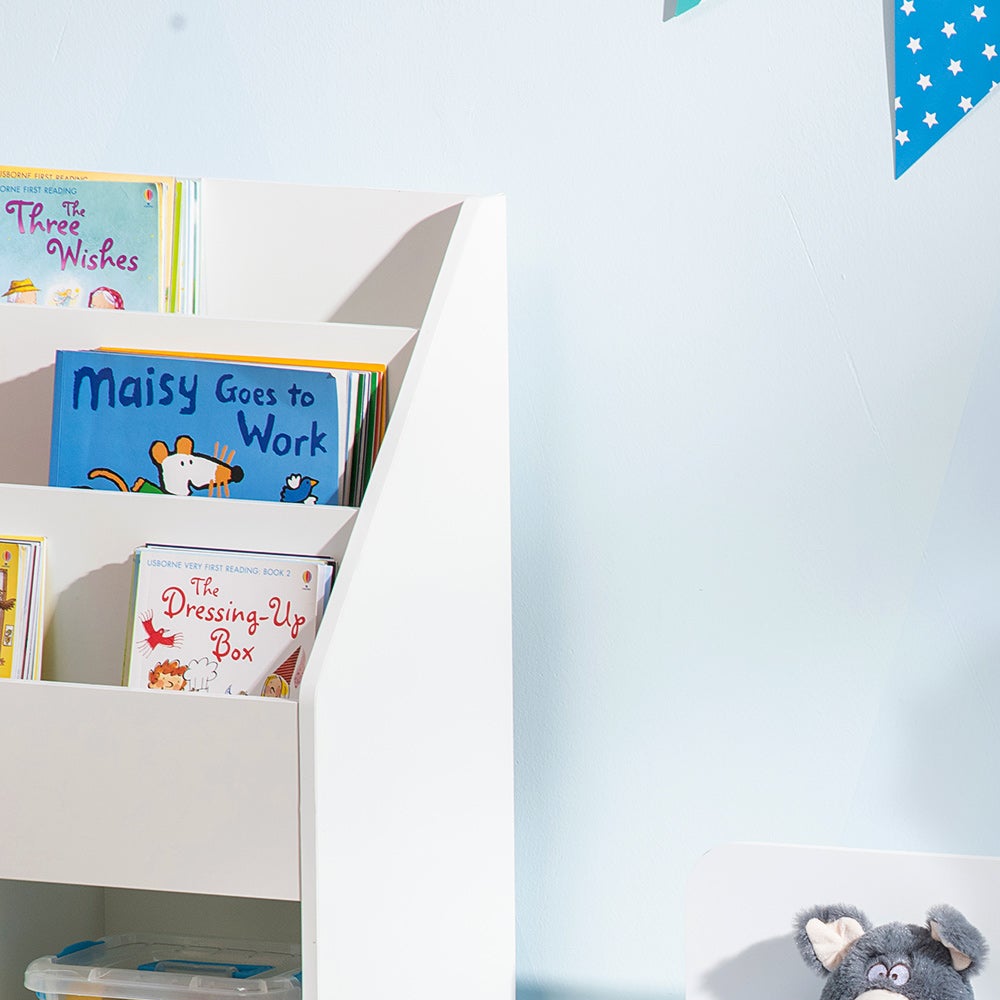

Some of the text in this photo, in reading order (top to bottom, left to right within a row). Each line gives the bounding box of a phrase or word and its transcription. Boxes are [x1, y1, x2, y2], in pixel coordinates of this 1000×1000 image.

[0, 170, 32, 179] SBORNE
[34, 172, 53, 180] FIRST
[23, 186, 41, 194] FIRST
[44, 187, 77, 195] READING
[5, 199, 81, 236] Three
[62, 200, 86, 217] The
[46, 237, 139, 272] Wishes
[72, 365, 315, 415] Maisy Goes to
[236, 409, 328, 457] Work
[147, 559, 182, 569] USBORNE
[184, 561, 203, 570] VERY
[205, 563, 223, 572] FIRST
[263, 567, 284, 577] BOOK
[286, 569, 291, 577] 2
[190, 576, 220, 598] The
[161, 586, 306, 640] Dressing-Up
[210, 627, 256, 663] Box
